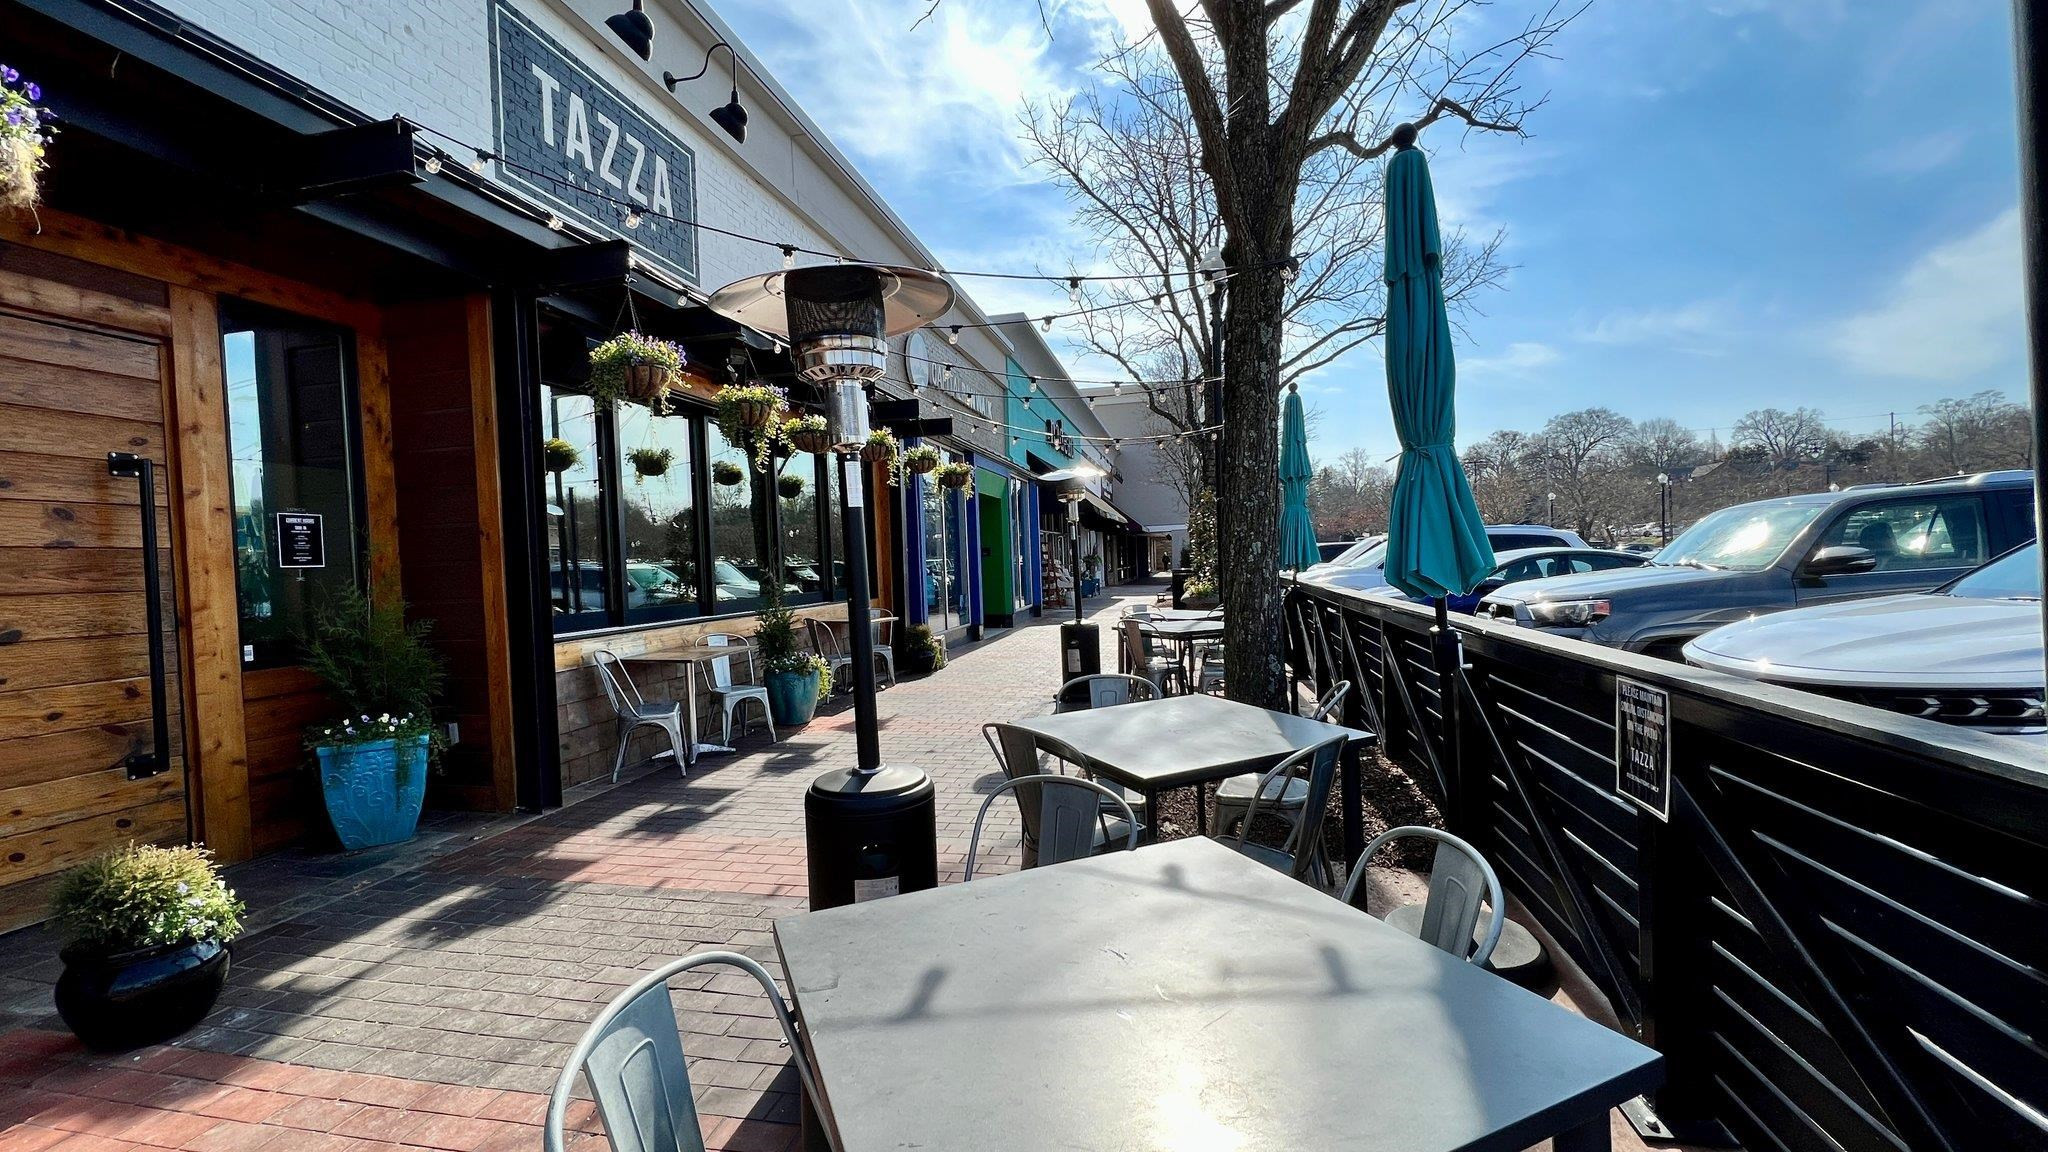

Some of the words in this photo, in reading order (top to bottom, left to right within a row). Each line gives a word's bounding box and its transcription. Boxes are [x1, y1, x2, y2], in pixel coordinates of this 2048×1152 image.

[532, 63, 674, 222] TAZZA
[1622, 684, 1639, 700] PLEASE
[1639, 689, 1663, 707] MAINTAIN
[1620, 700, 1636, 716] SOCIAL
[1637, 706, 1665, 726] DISTANCING
[1627, 719, 1634, 731] ON
[1635, 722, 1643, 736] THE
[1644, 725, 1658, 741] PATIO
[1630, 746, 1655, 771] TAZZA
